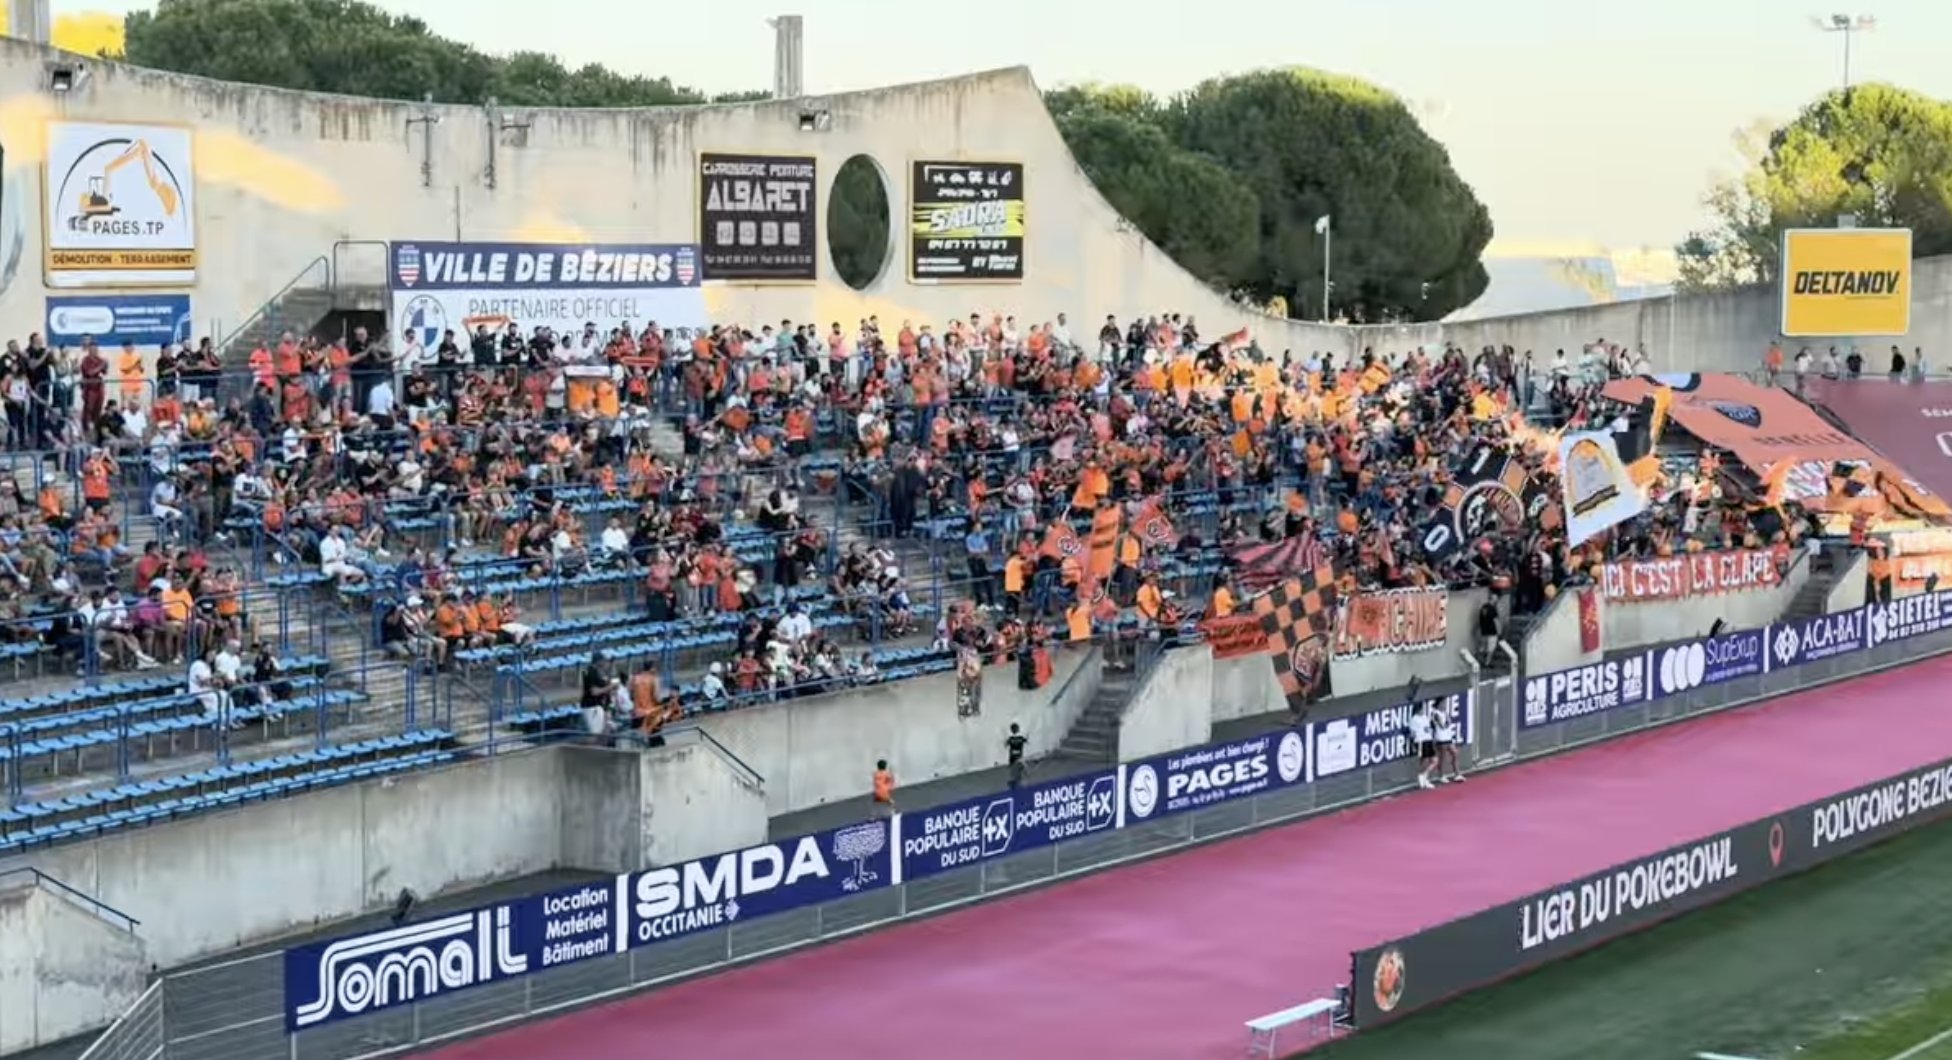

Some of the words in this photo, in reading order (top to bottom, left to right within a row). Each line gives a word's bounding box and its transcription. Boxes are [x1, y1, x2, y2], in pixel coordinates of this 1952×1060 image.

[424, 252, 509, 283] VILLE
[514, 252, 551, 283] DE
[559, 247, 673, 283] BÉZIERS
[1793, 270, 1900, 295] DELTANOV
[469, 297, 568, 320] PARTENAIRE
[572, 297, 641, 319] OFFICIEL
[1602, 563, 1625, 597] ICI
[1631, 560, 1682, 596] C'EST
[1690, 556, 1715, 590] LA
[1888, 591, 1941, 628] SIETEL
[1551, 661, 1619, 705] PERIS
[1551, 690, 1619, 720] AGRICULTURE
[1167, 754, 1270, 799] PAGES
[1033, 782, 1086, 808] BANQUE
[924, 805, 981, 835] BANQUE
[1016, 800, 1085, 831] POPULAIRE
[1049, 824, 1065, 840] DU
[1065, 820, 1085, 836] SUD
[1812, 780, 1906, 848] POLYGONE
[905, 824, 981, 857] POPULAIRE
[941, 851, 957, 868] DU
[958, 845, 981, 863] SUD
[635, 835, 831, 919] SMDA
[1580, 875, 1612, 930] DU
[1614, 836, 1738, 916] POKEBOWL
[543, 886, 609, 916] Location
[545, 907, 608, 941] Matériel
[638, 902, 724, 941] OCCITANIE
[542, 932, 609, 967] Bâtiment
